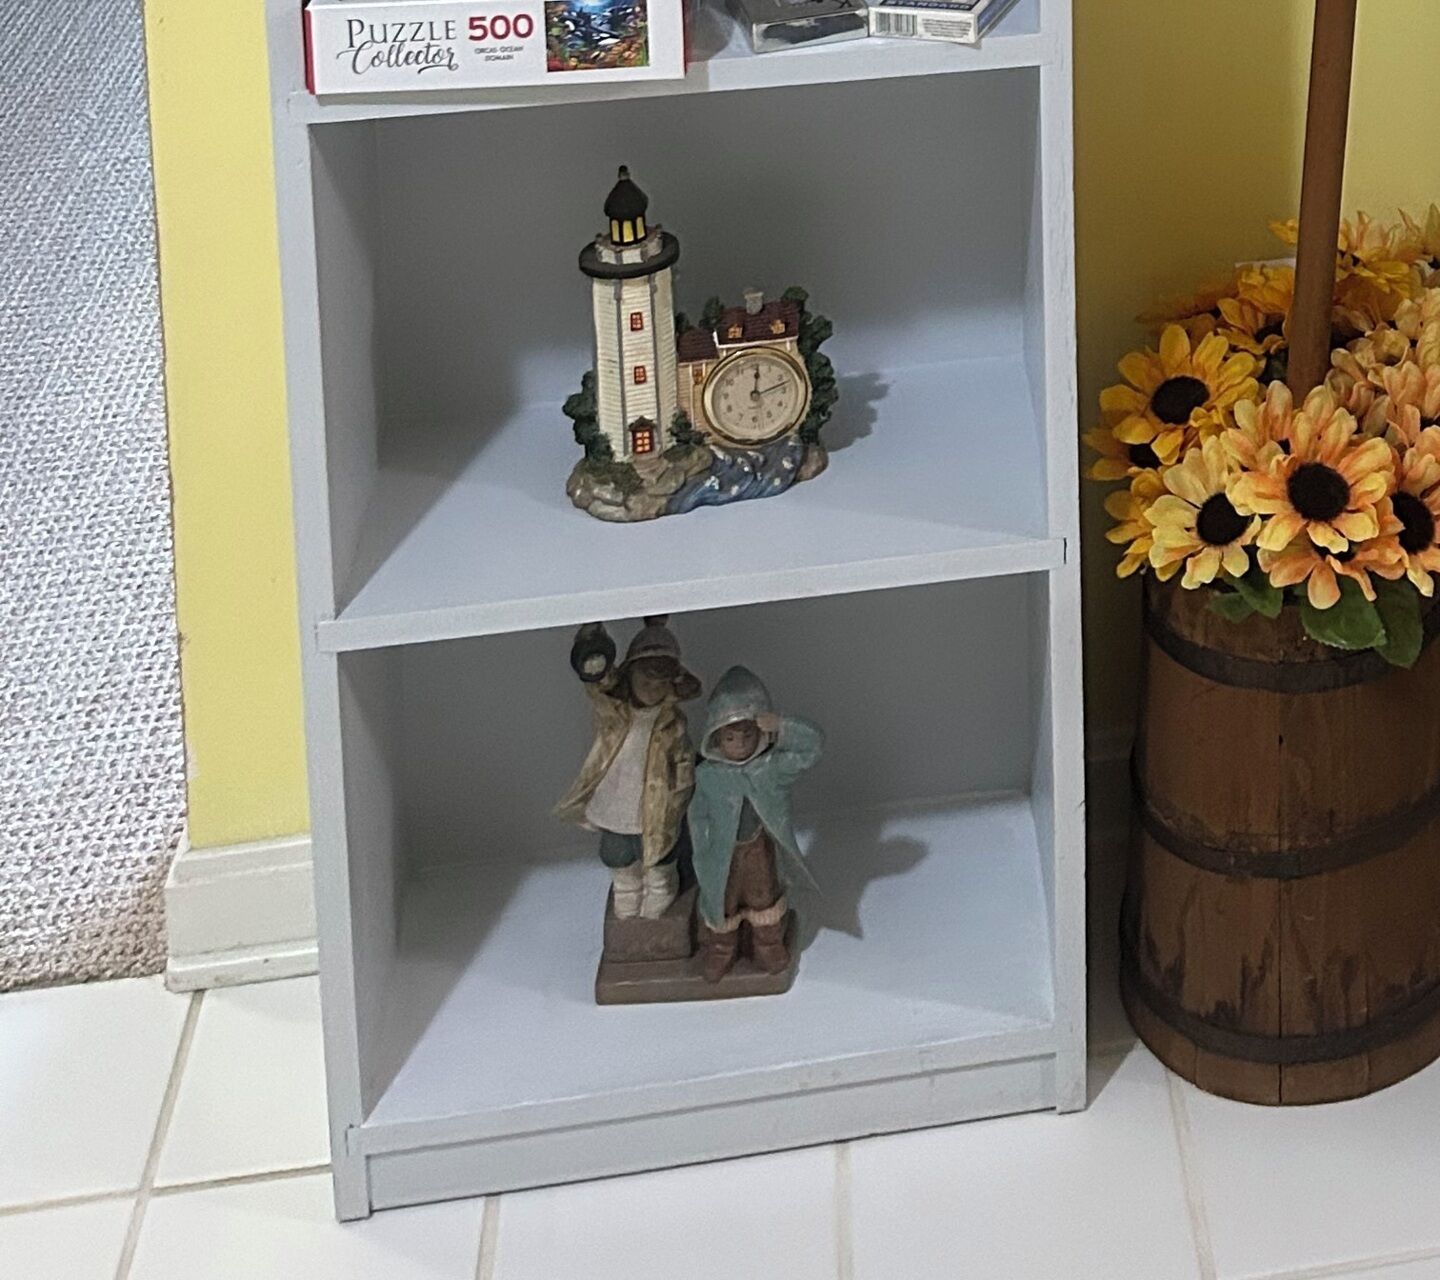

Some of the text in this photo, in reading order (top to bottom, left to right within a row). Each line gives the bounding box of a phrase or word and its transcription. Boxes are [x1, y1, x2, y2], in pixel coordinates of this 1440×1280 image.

[885, 0, 972, 11] STANDARD
[347, 19, 457, 49] PUZZLE
[468, 13, 534, 41] 500
[336, 39, 460, 76] Collector
